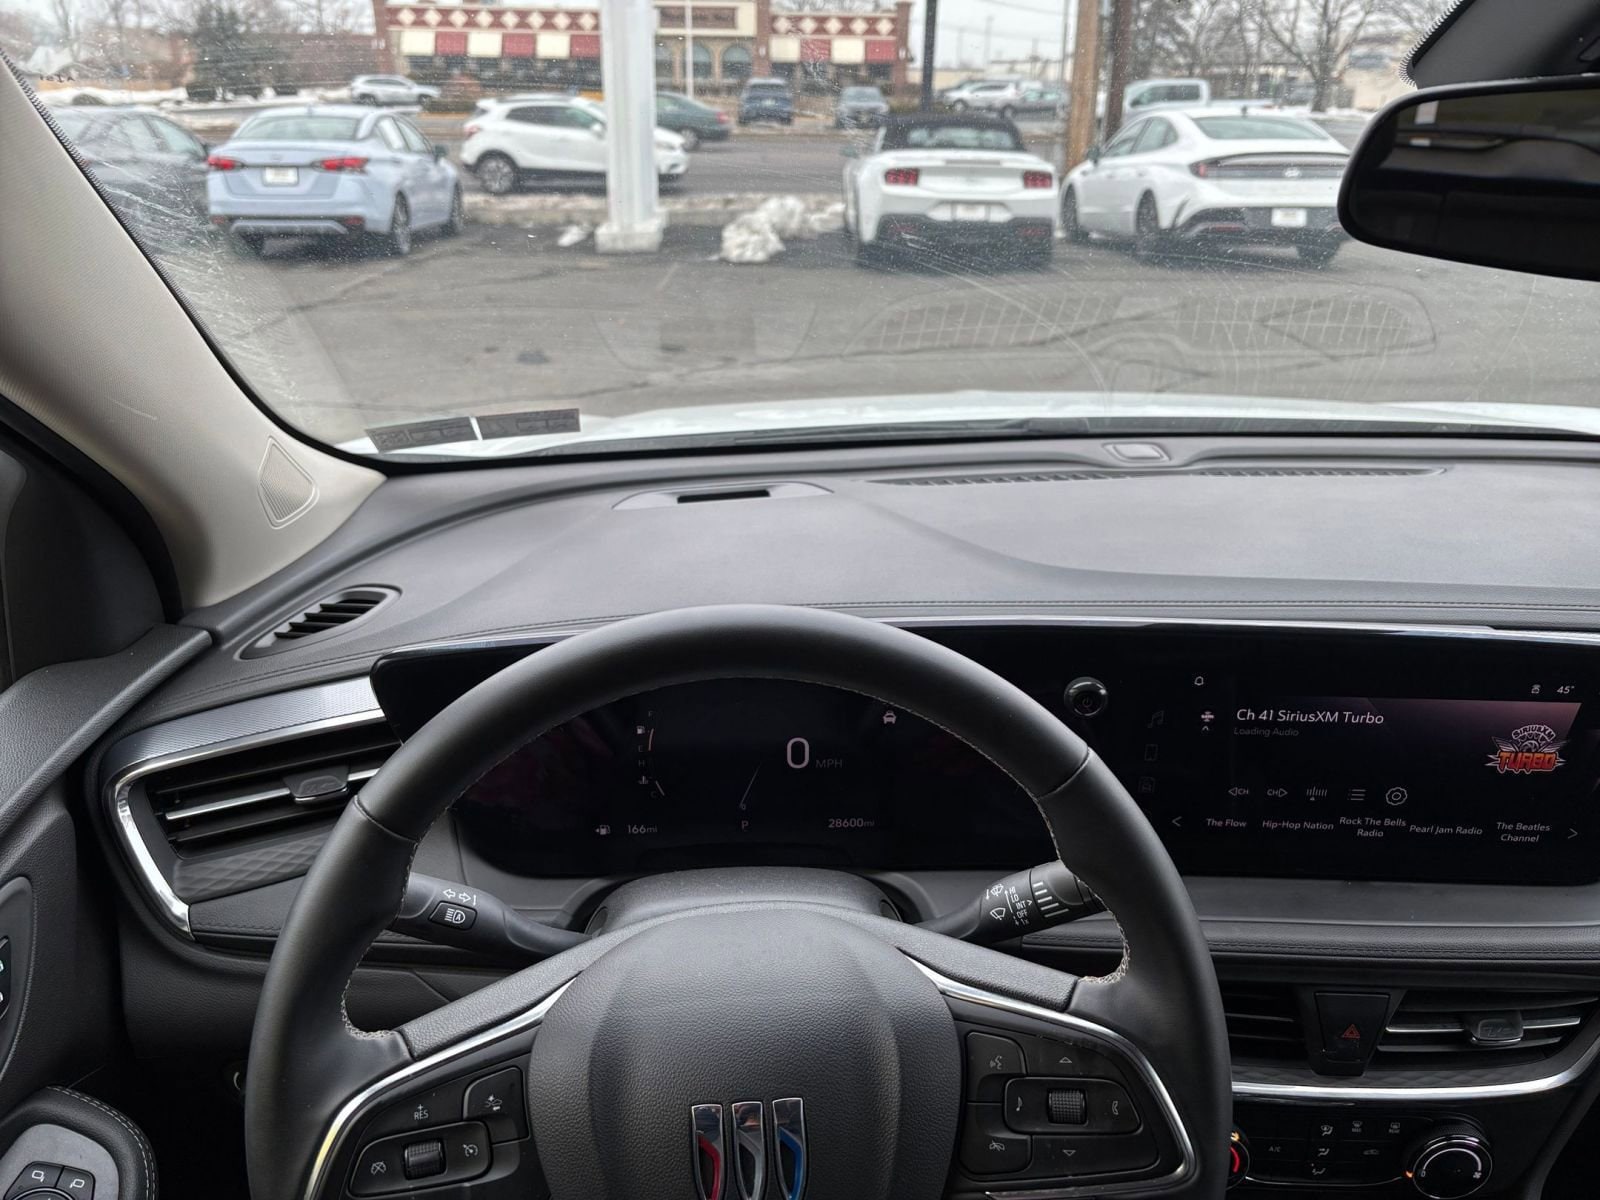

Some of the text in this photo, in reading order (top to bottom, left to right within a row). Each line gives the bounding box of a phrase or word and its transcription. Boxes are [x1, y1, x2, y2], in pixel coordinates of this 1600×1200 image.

[1236, 709, 1384, 724] Ch 41 SiriusXM Turbo
[1233, 727, 1300, 738] Loading Audio
[786, 737, 843, 769] 0 MPH
[1498, 751, 1558, 774] TURBO
[1267, 788, 1279, 796] CH
[741, 819, 749, 830] P
[1206, 818, 1247, 828] The Flow
[1262, 820, 1334, 830] Hip-Hop Nation
[1339, 816, 1407, 827] Rock The Bells
[1496, 821, 1551, 832] The Beatles
[1357, 828, 1384, 837] Radio
[1409, 824, 1483, 835] Pearl Jam Radio
[1500, 833, 1540, 843] Channel
[1016, 908, 1028, 919] OFF
[413, 1109, 429, 1121] RES
